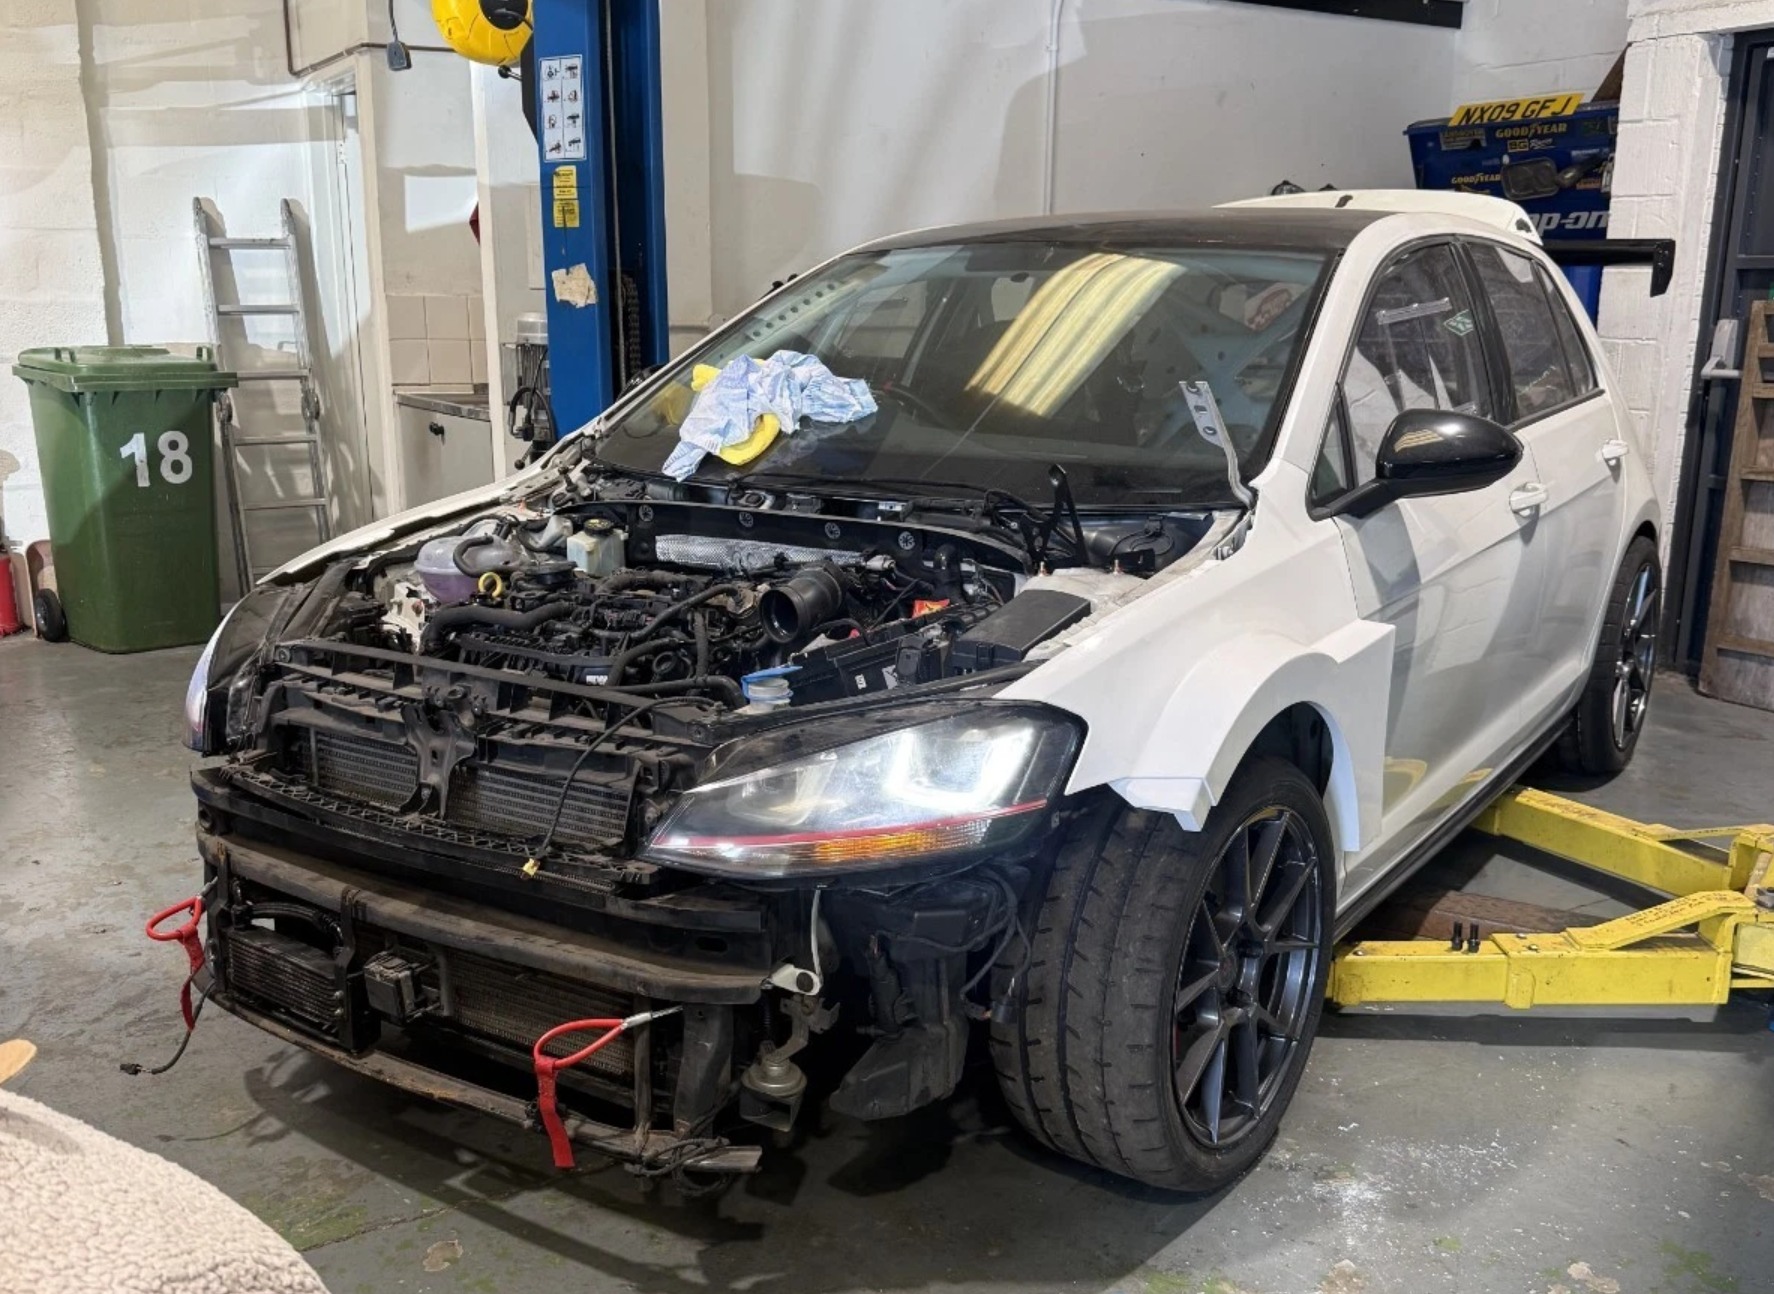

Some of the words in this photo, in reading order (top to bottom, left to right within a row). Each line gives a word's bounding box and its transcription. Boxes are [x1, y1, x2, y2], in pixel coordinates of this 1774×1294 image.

[1458, 102, 1520, 125] NX09
[1521, 96, 1573, 118] GFJ
[1495, 122, 1567, 139] GOODYEAR
[1451, 173, 1502, 185] GOODYEAR
[119, 430, 193, 487] 18
